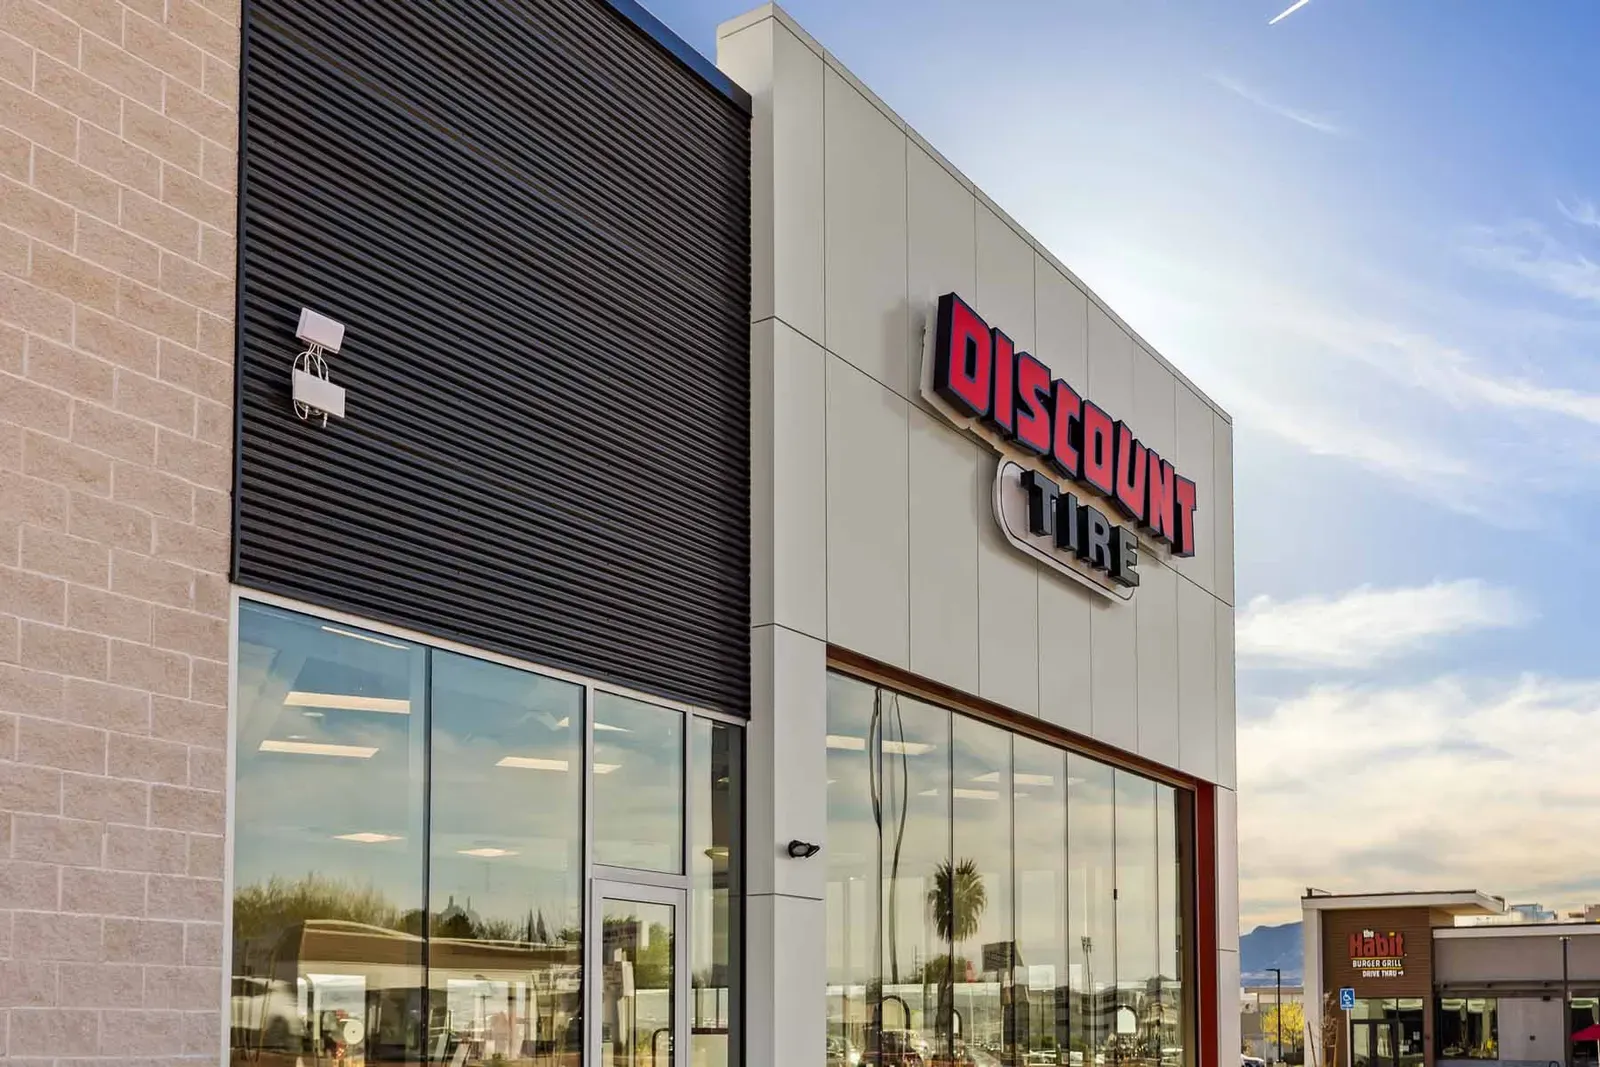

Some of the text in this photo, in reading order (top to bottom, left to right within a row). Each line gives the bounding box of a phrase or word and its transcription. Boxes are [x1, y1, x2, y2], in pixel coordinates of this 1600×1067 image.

[933, 291, 1197, 558] DISCOUNT
[1020, 469, 1140, 589] TIRE
[1349, 932, 1404, 957] Habit
[1352, 959, 1402, 968] BURGER GRILL
[1362, 970, 1380, 978] DRIVE
